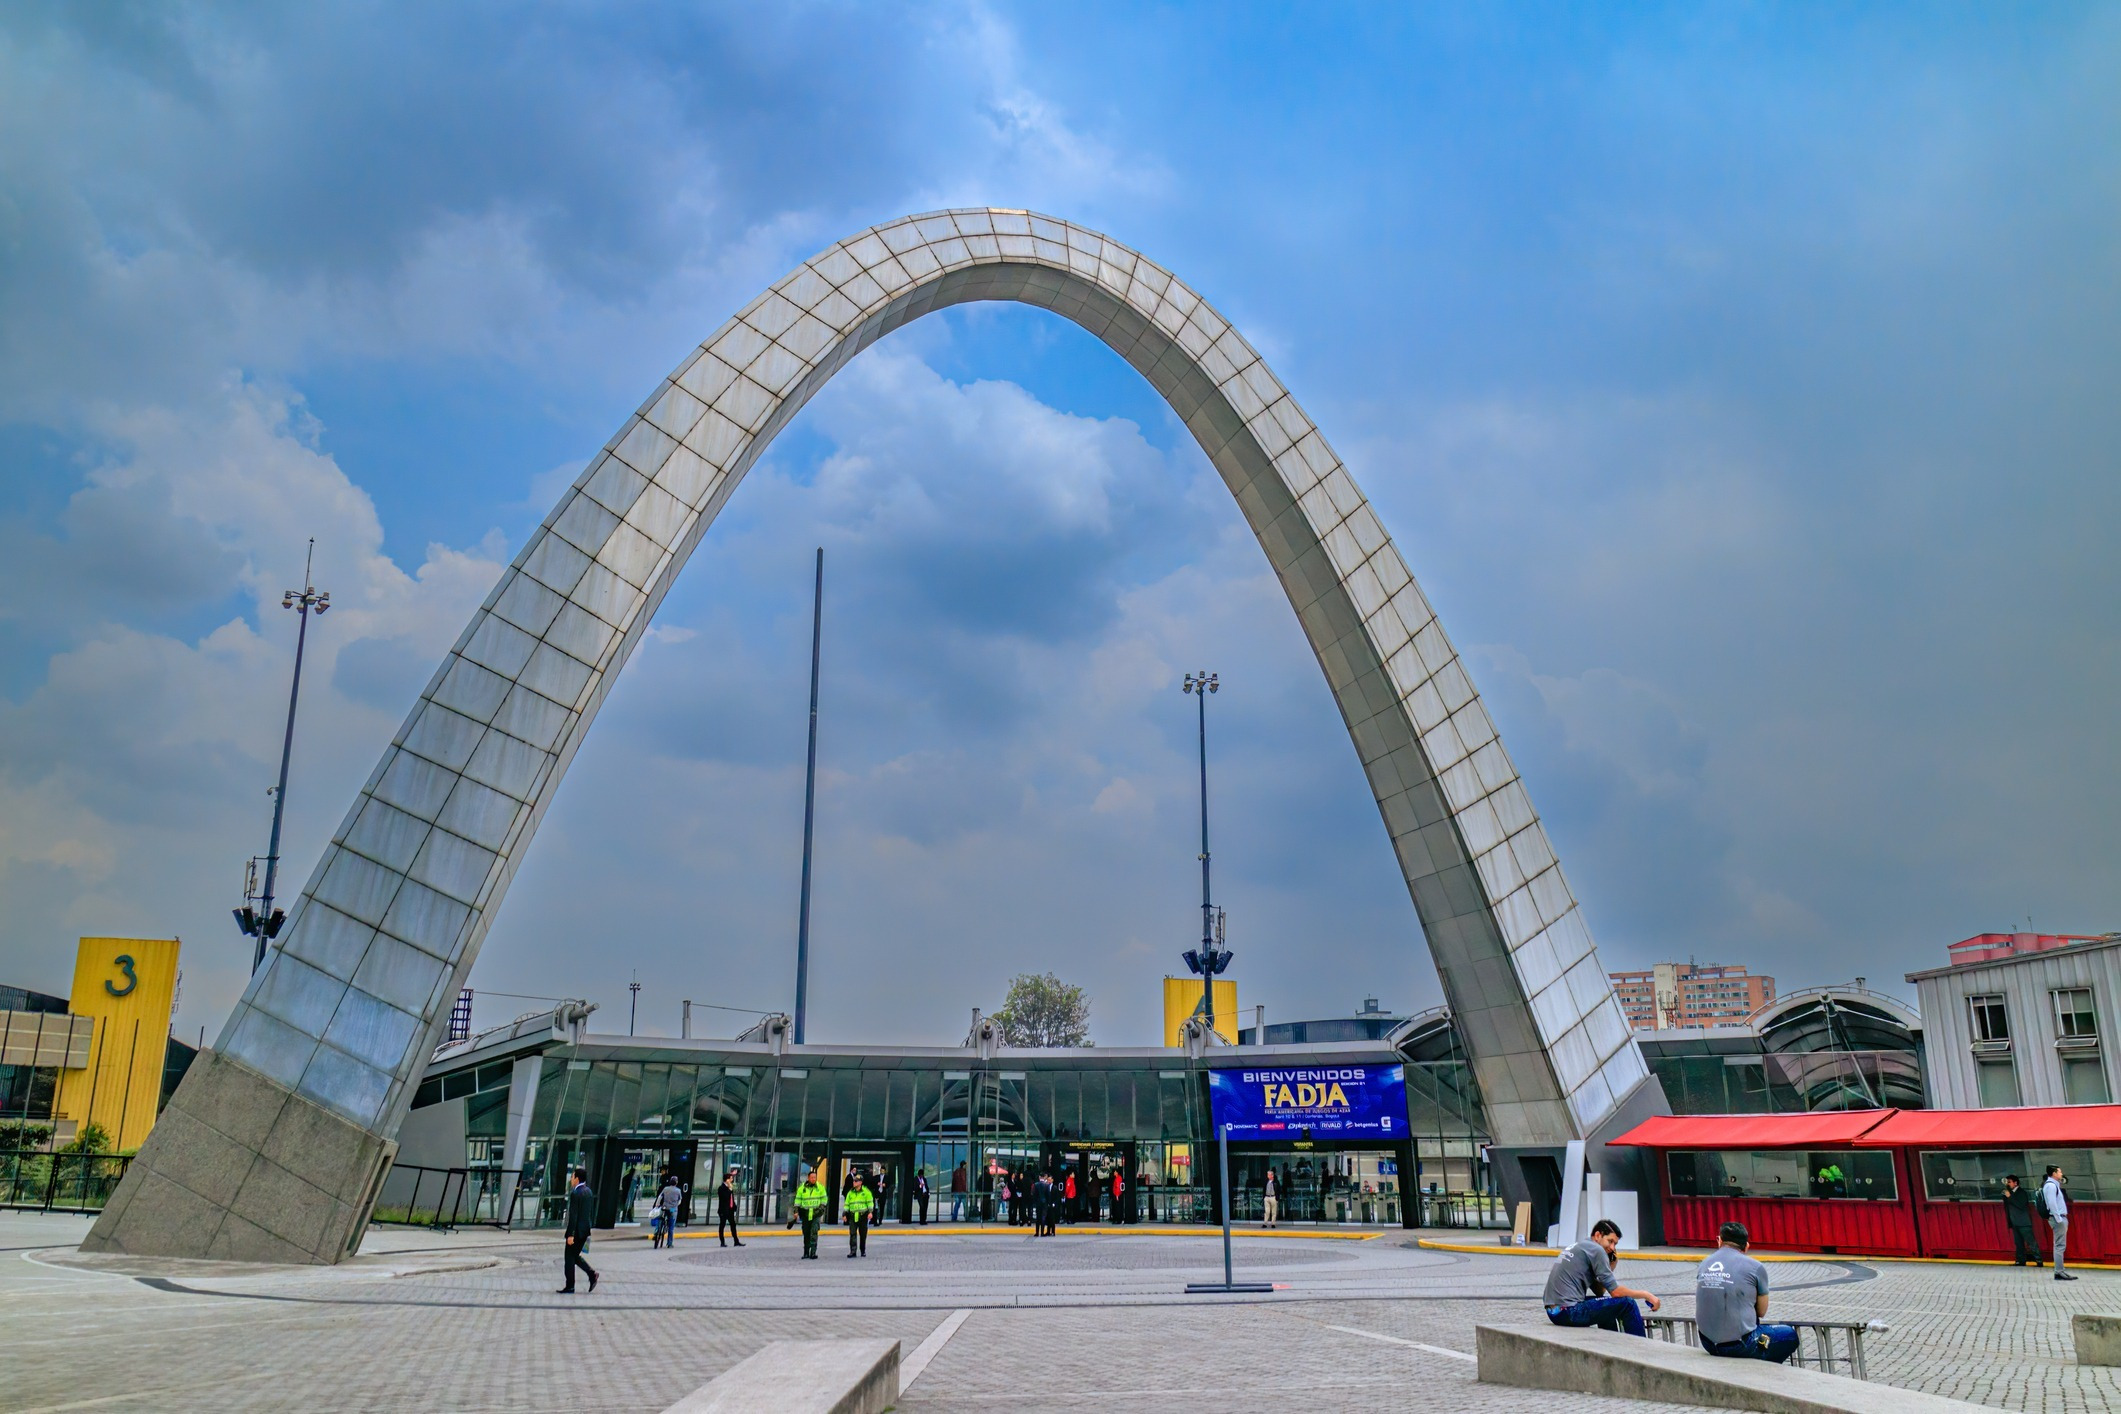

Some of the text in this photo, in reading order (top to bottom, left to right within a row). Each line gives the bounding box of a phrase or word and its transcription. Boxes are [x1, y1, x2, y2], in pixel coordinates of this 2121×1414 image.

[105, 954, 137, 997] 3
[1243, 1069, 1366, 1083] BIENVENIDOS
[1263, 1082, 1350, 1108] FADJA
